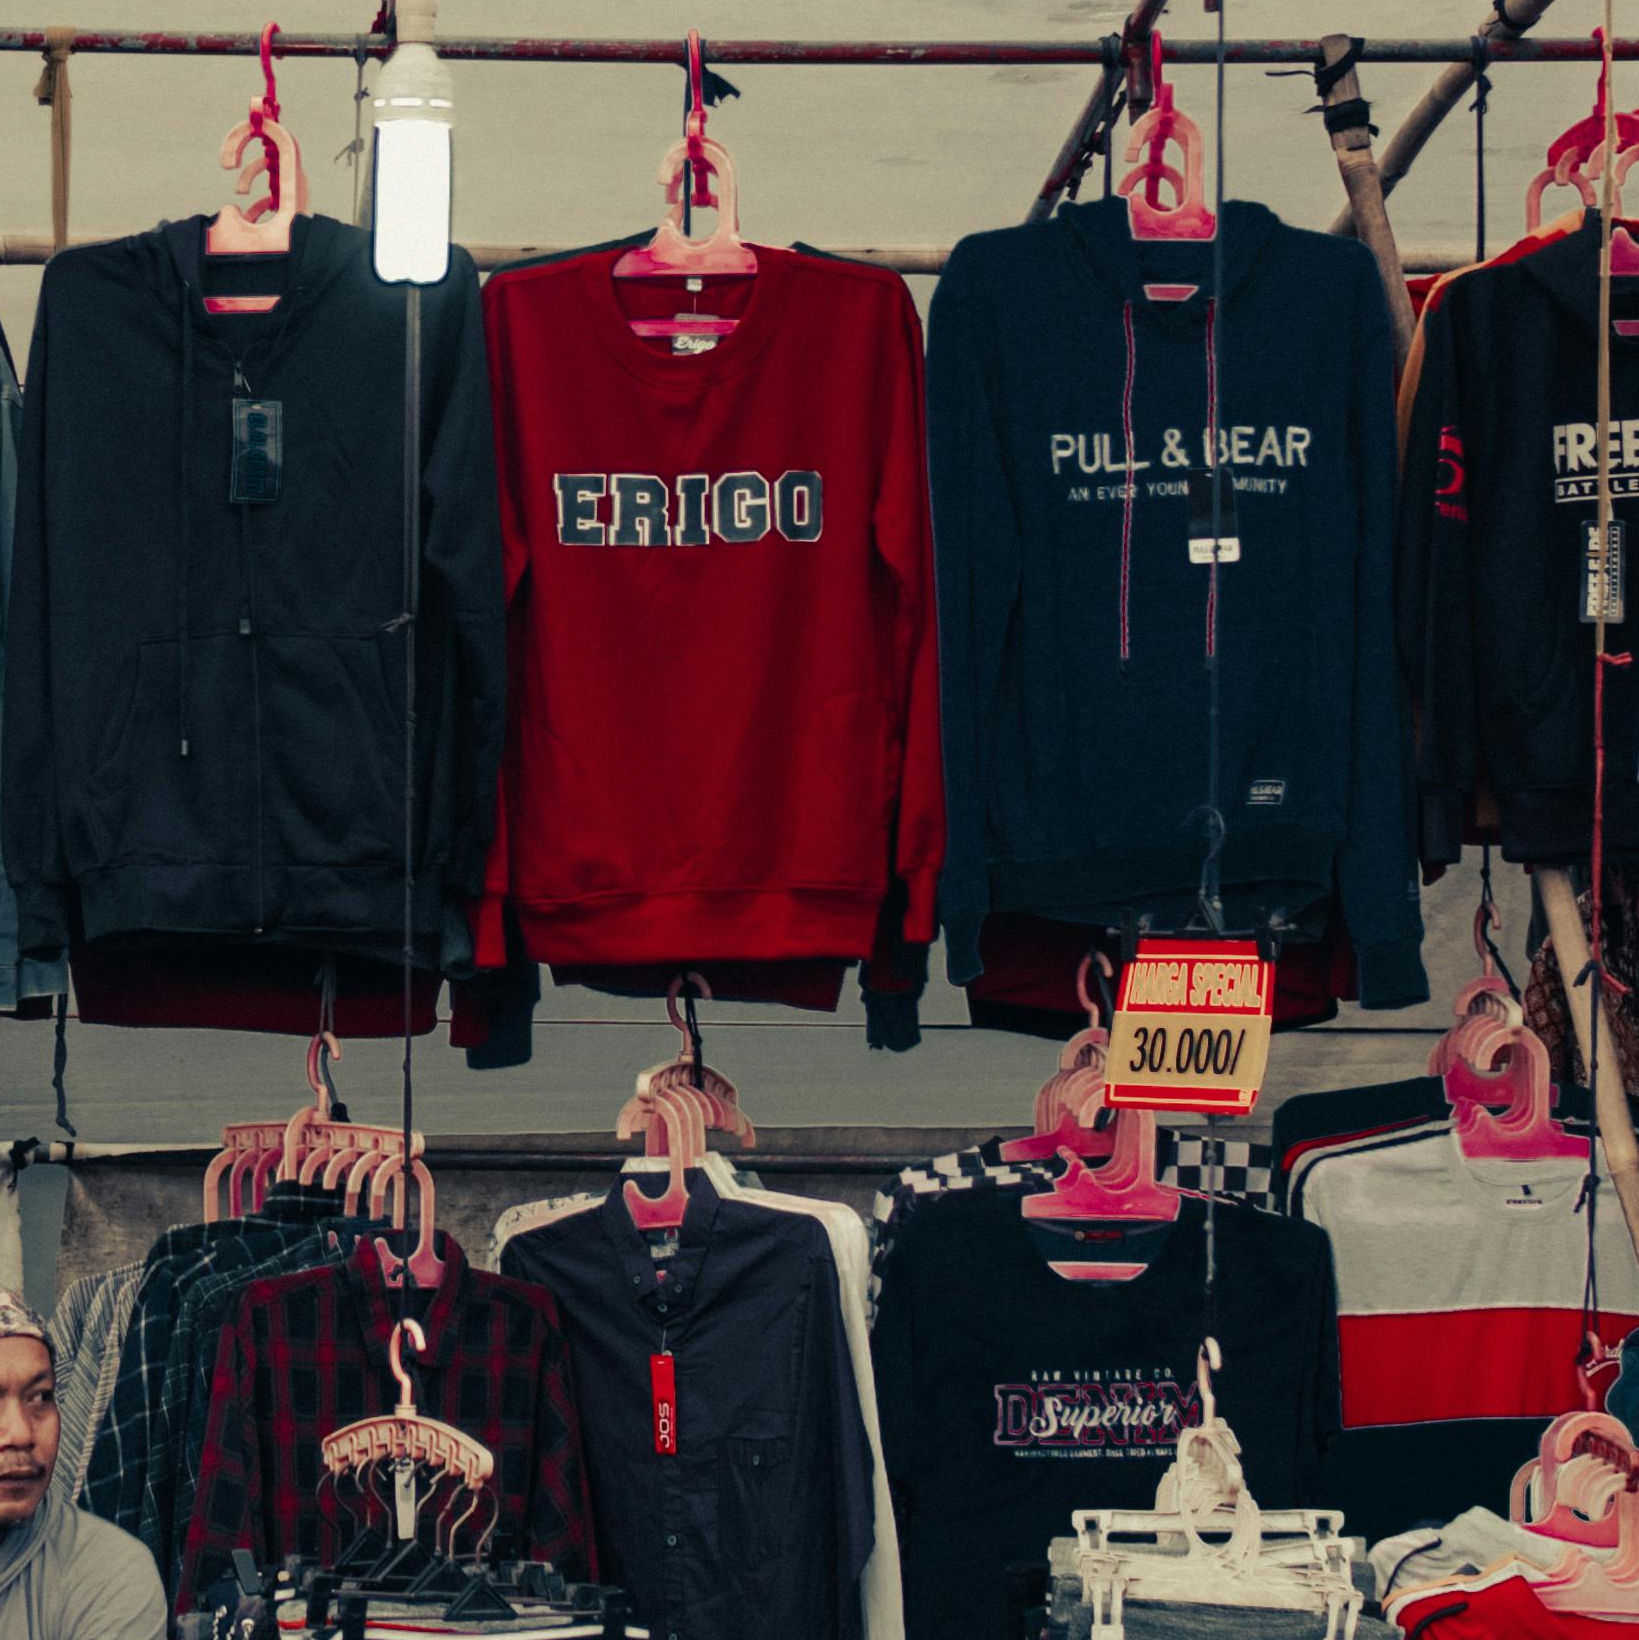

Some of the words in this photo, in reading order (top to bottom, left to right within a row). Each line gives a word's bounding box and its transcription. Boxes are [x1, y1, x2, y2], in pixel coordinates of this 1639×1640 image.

[674, 336, 716, 354] Erigo
[1050, 433, 1150, 474] PULL
[1161, 428, 1190, 467] &
[1203, 425, 1310, 467] BEAR
[553, 470, 823, 546] ERIGO
[1147, 480, 1189, 497] YOUN
[1557, 479, 1639, 496] BATLE
[1129, 962, 1188, 1006] HARGA
[1189, 962, 1262, 1008] SPECIAL
[1129, 1027, 1246, 1075] 30.000/
[659, 1402, 670, 1448] JOS
[1029, 1396, 1178, 1439] Superior
